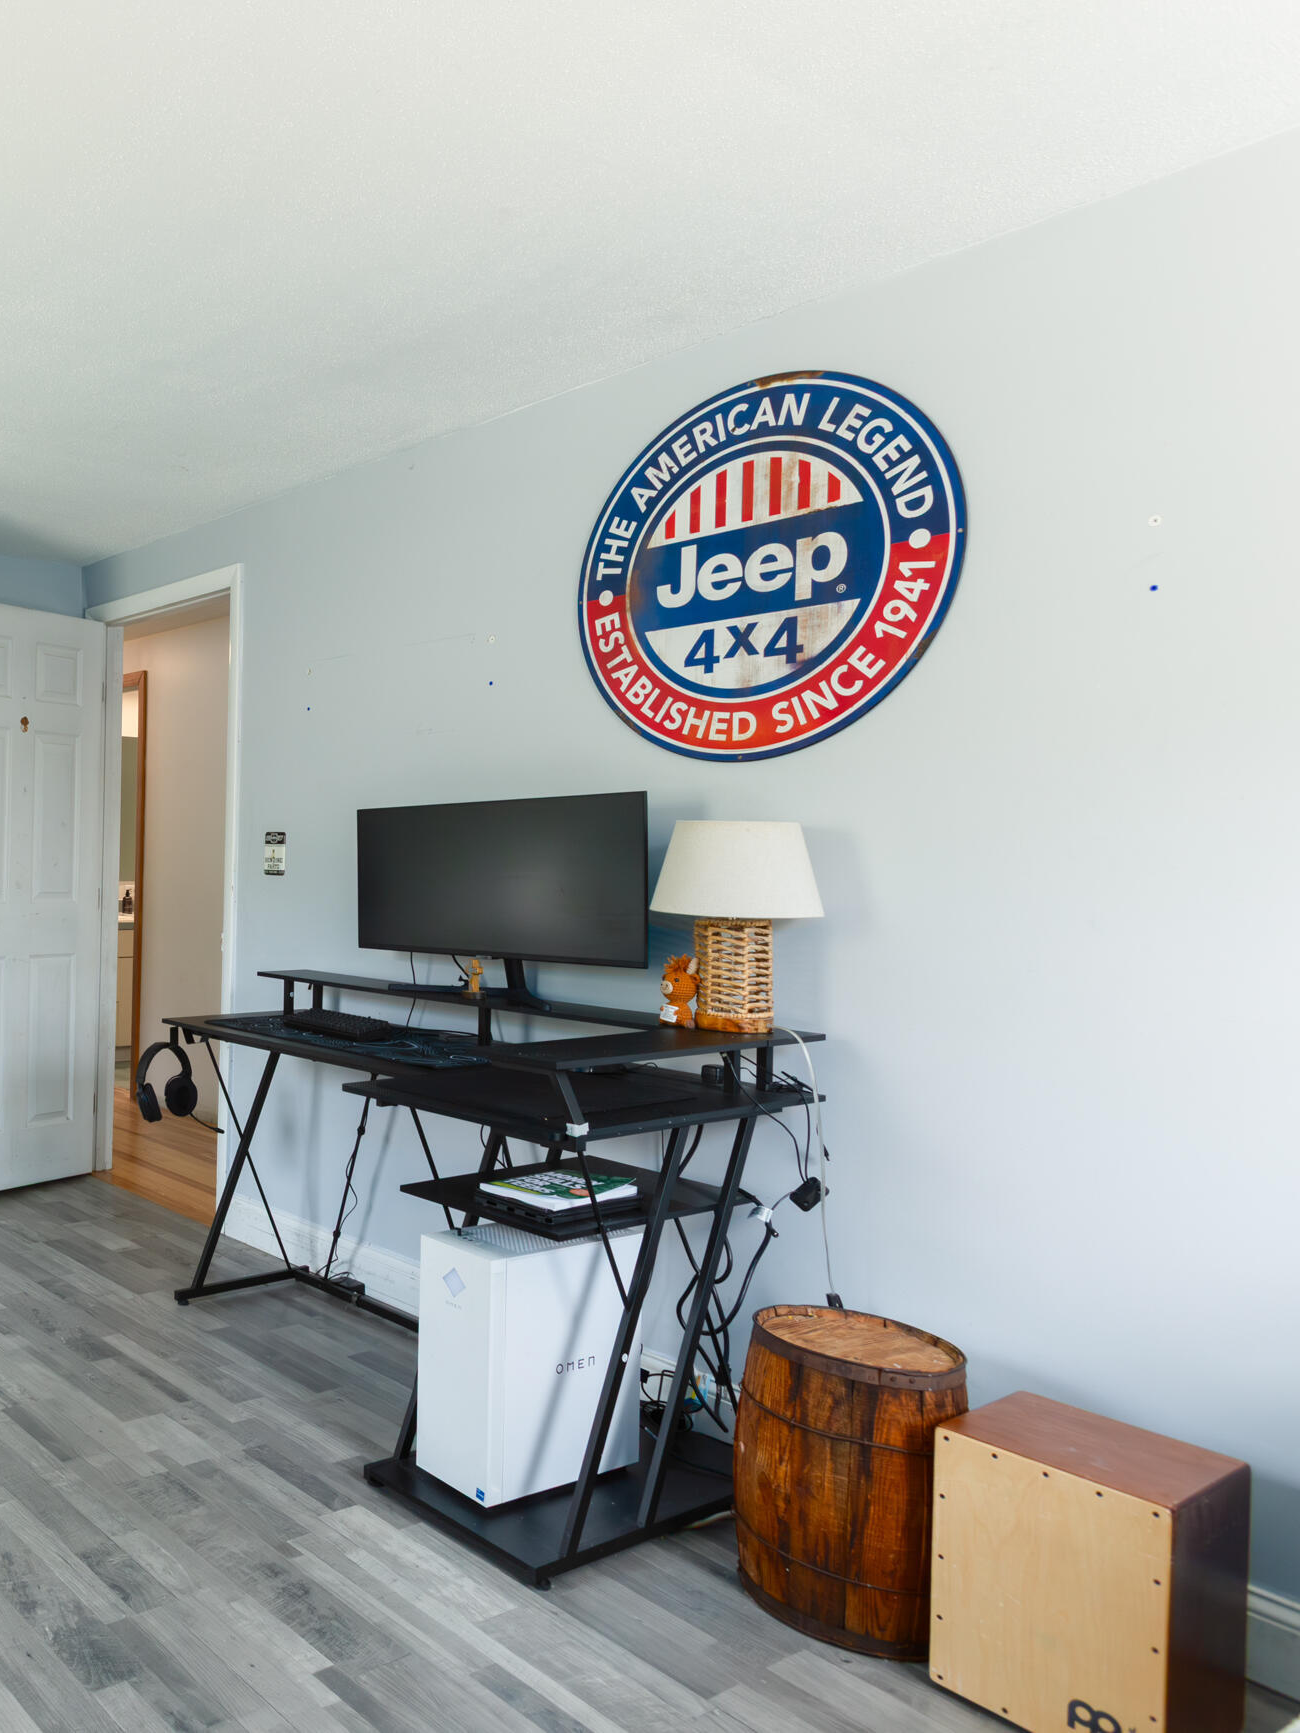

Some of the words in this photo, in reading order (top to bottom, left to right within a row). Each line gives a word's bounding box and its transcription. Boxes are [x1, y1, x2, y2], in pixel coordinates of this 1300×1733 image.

[596, 516, 638, 580] THE
[630, 392, 811, 514] AMERICAN
[817, 396, 935, 520] LEGEND
[655, 530, 849, 609] Jeep
[594, 610, 758, 742] ESTABLISHED
[771, 645, 886, 734] SINCE
[874, 560, 937, 640] 1941
[555, 1355, 596, 1375] OMEN
